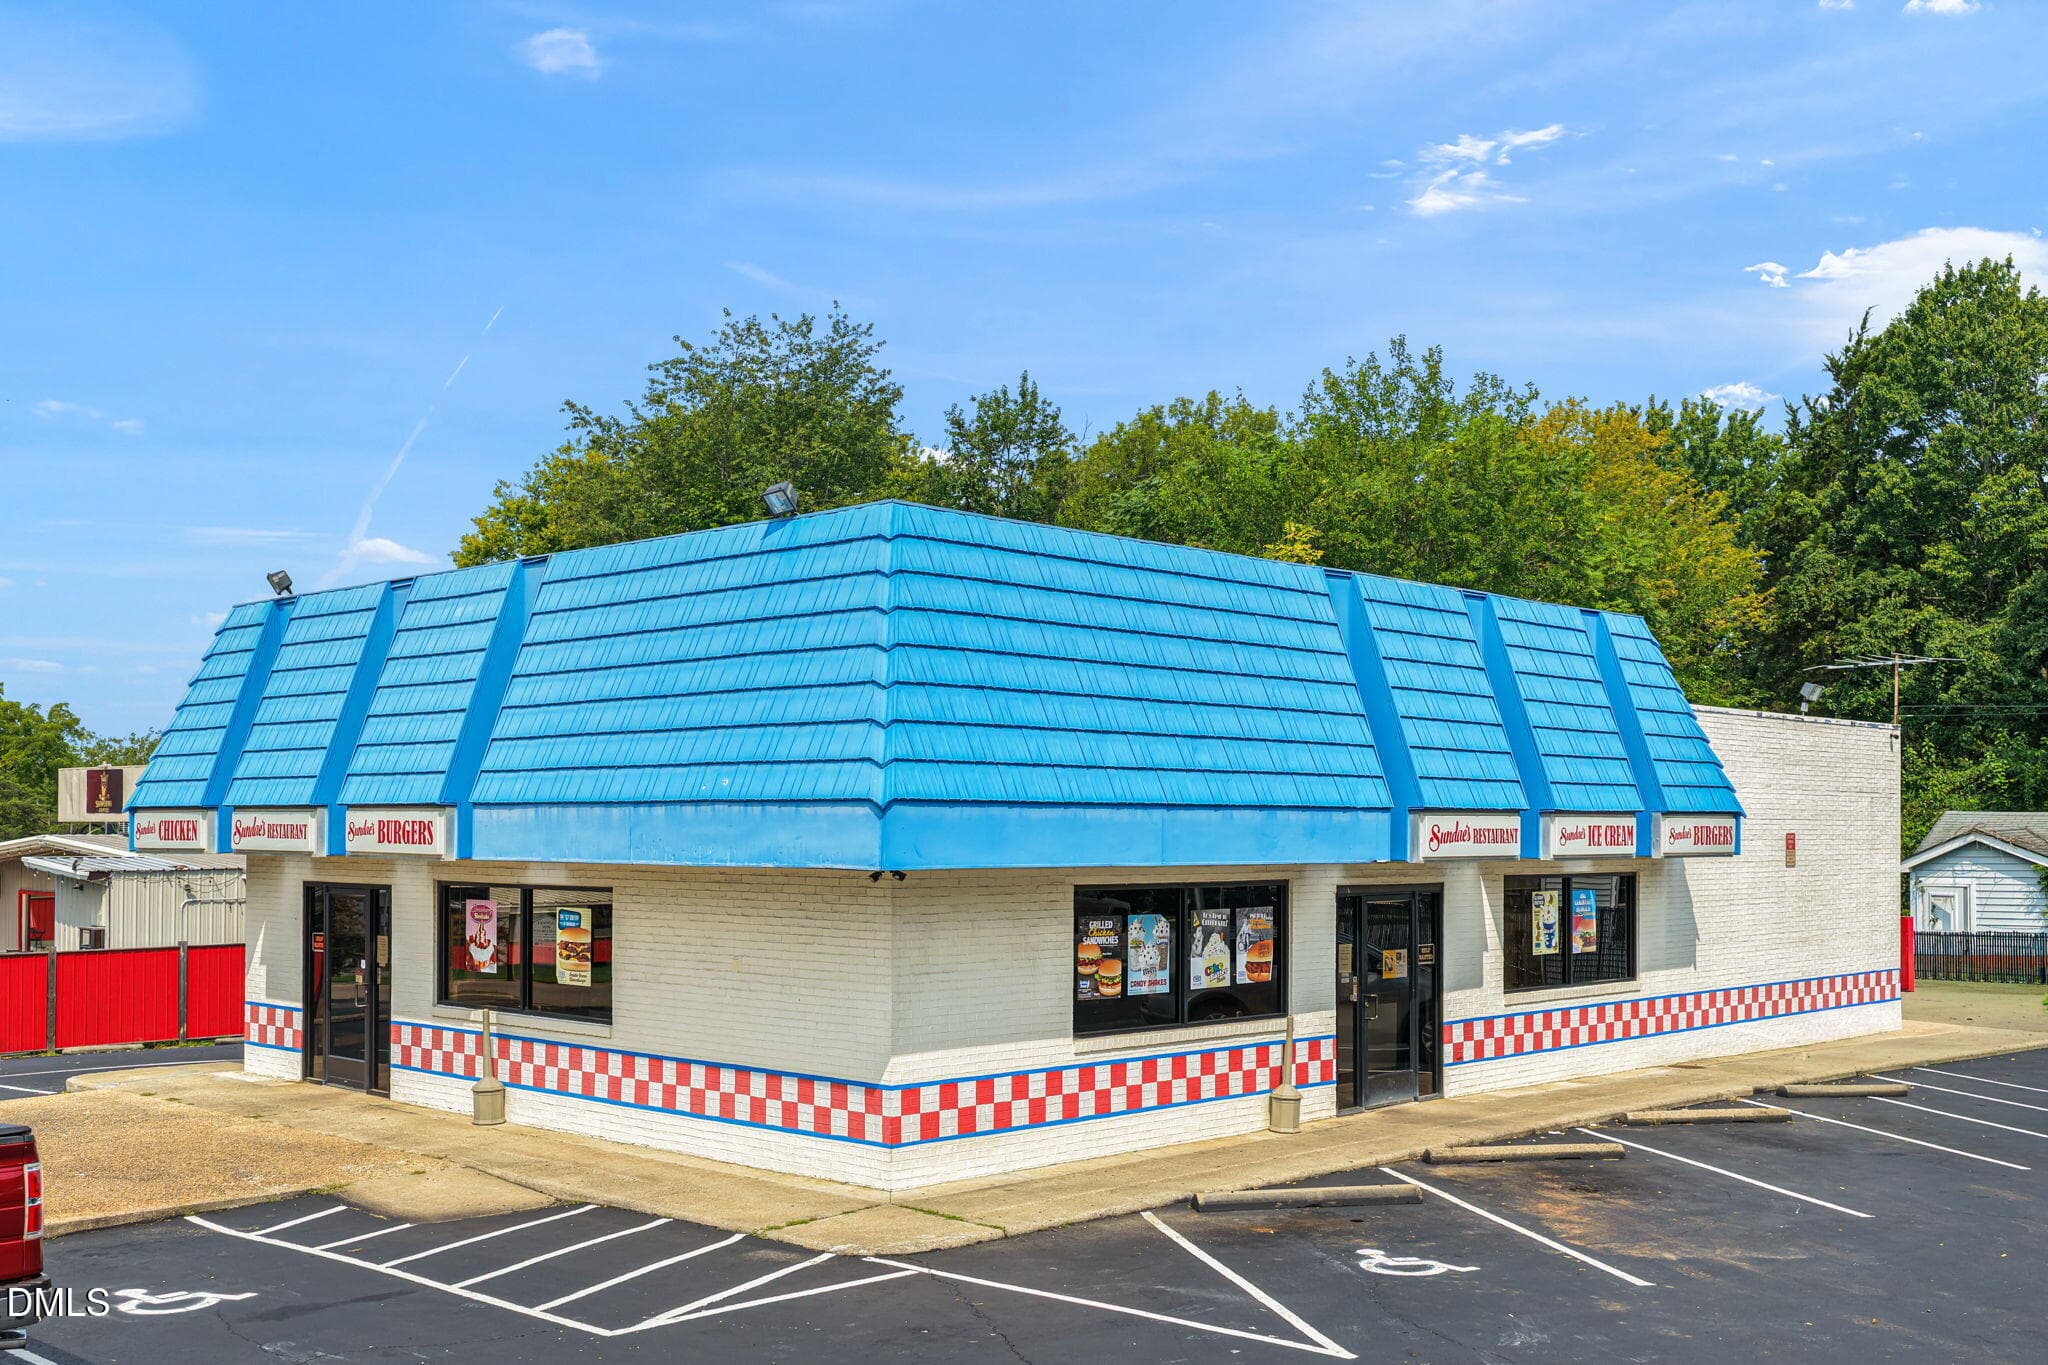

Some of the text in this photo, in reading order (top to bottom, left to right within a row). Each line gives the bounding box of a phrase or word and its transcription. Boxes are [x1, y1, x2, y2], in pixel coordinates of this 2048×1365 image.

[136, 819, 198, 841] Sundae's CHICKEN
[233, 816, 308, 845] Sundae's RESTAURANT
[347, 820, 434, 846] Sundae's BURGERS
[1428, 821, 1518, 852] Sundae's RESTAURANT
[1560, 825, 1634, 846] Sundae's ICE CREAM
[1669, 825, 1733, 846] Sundae's BURGERS
[1089, 920, 1113, 929] GRILLED
[1082, 935, 1119, 945] SANDWICHES
